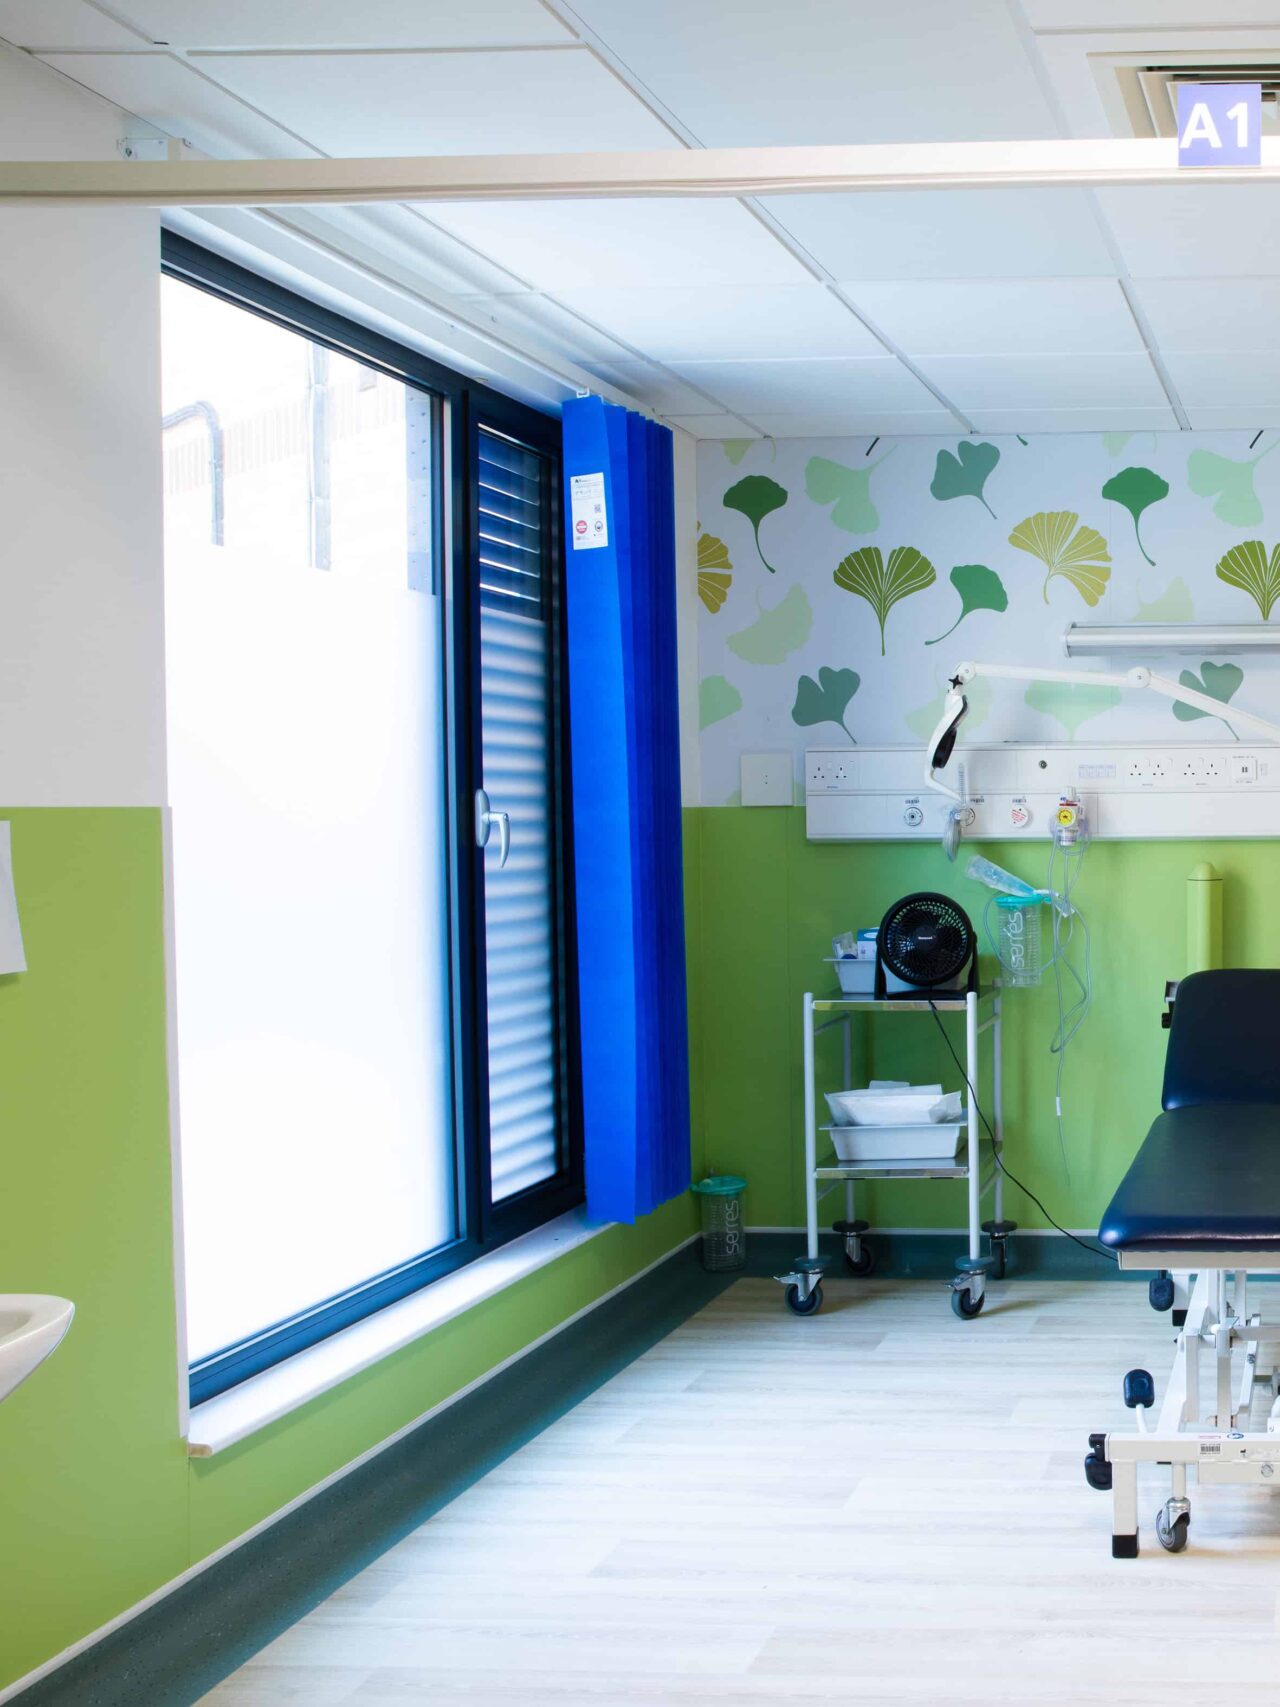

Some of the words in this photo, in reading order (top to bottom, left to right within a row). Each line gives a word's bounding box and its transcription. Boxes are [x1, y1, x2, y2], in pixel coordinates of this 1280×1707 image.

[1179, 102, 1248, 148] A1
[1008, 911, 1025, 968] serres
[725, 1199, 739, 1255] serres
